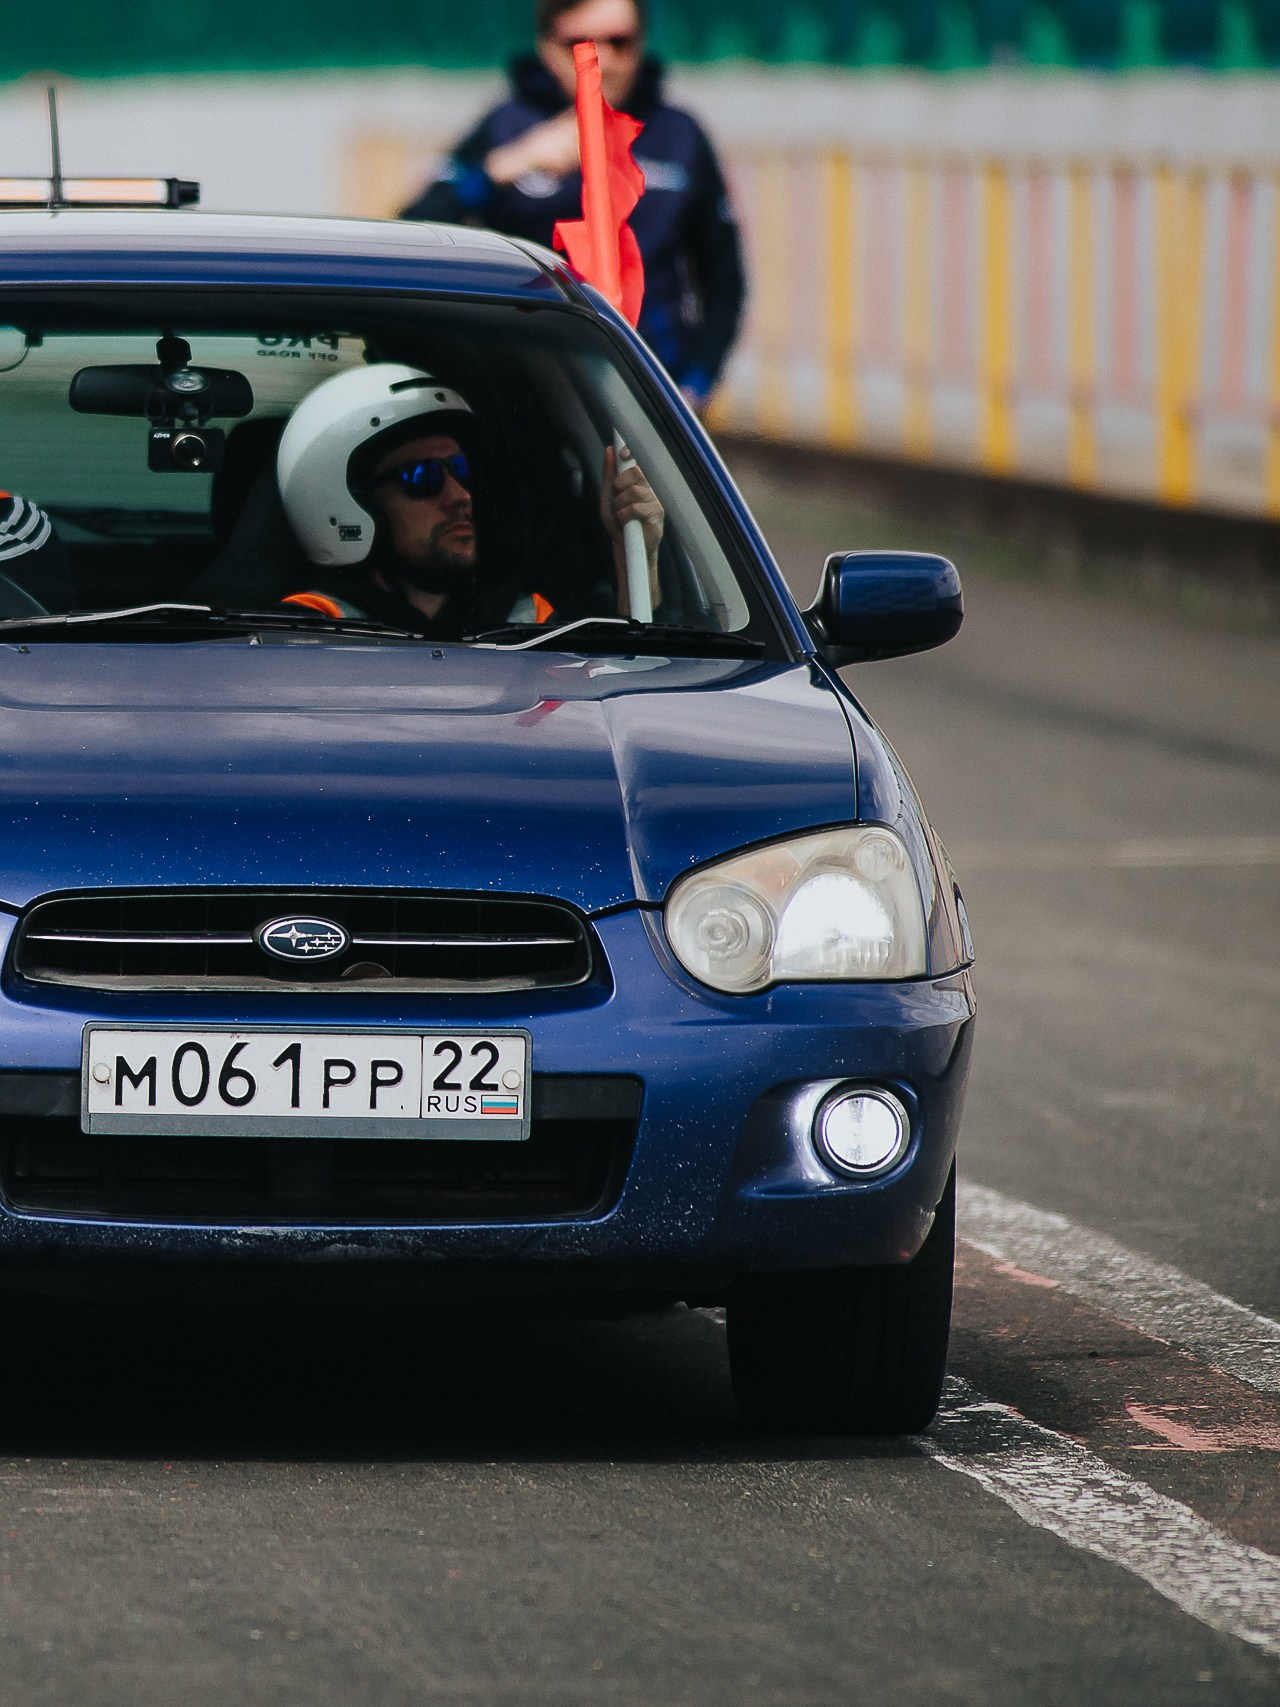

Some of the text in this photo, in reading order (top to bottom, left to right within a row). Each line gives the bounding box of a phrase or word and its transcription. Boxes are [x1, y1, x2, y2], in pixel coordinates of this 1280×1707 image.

[339, 527, 361, 539] OMP
[115, 1041, 499, 1109] M061PP 22
[428, 1096, 477, 1113] RUS
